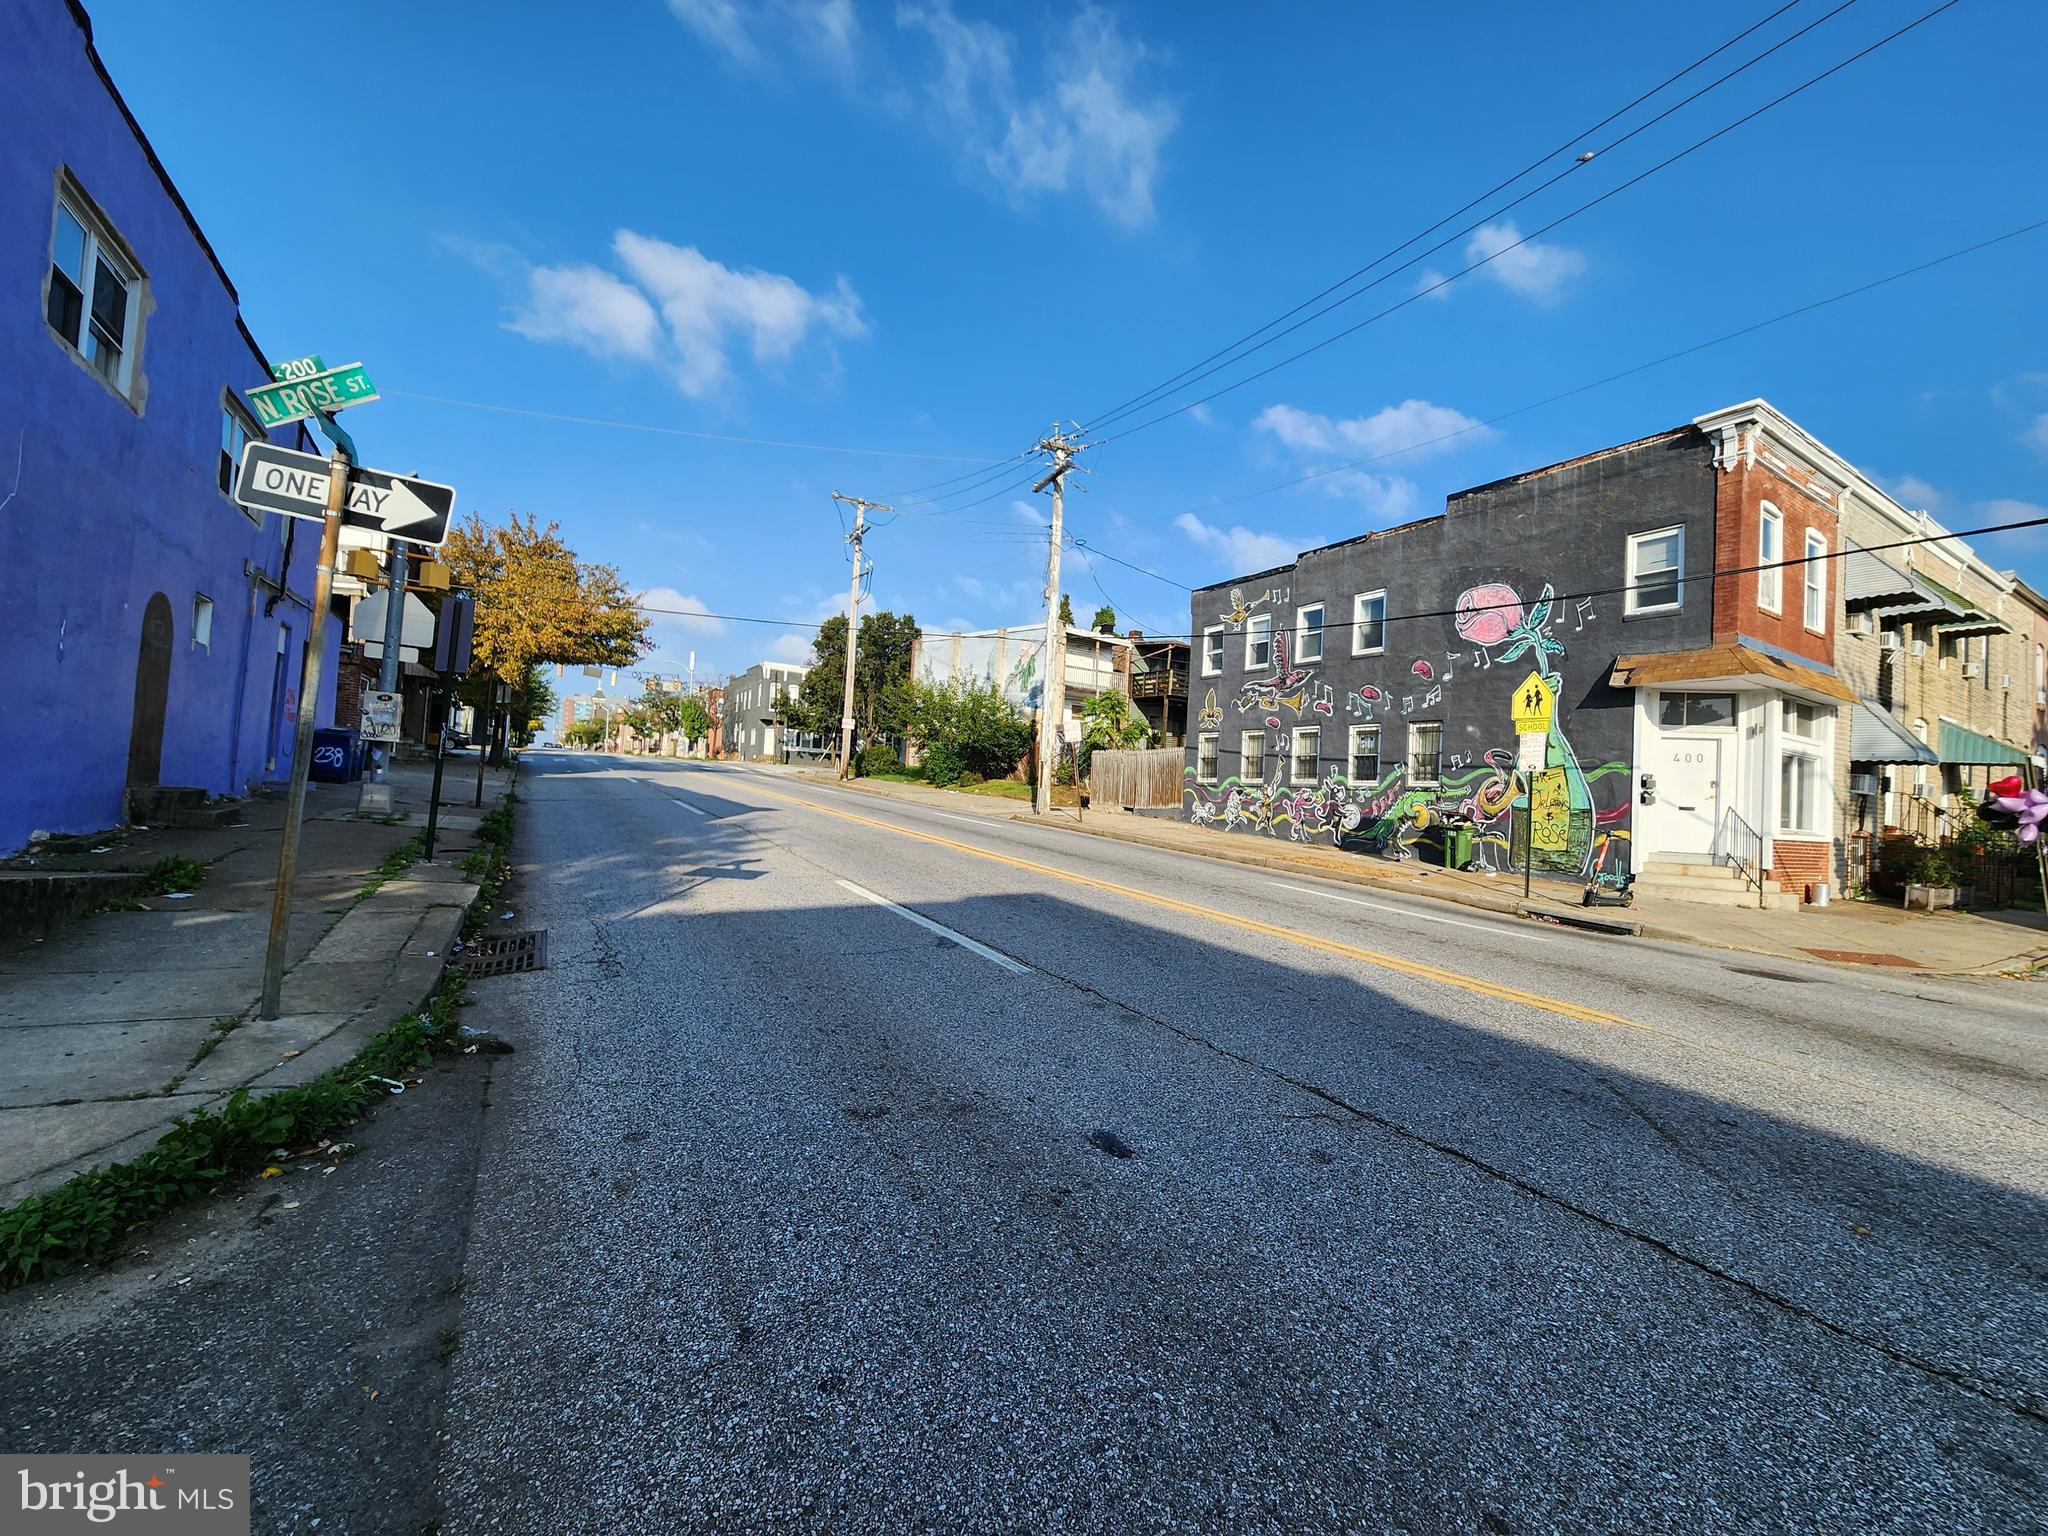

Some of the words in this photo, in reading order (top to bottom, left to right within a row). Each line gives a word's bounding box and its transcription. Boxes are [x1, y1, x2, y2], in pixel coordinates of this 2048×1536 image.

[281, 358, 317, 380] 200
[252, 395, 282, 422] N.
[279, 376, 345, 416] ROSE
[345, 375, 371, 393] ST.
[265, 468, 325, 501] ONE
[347, 484, 390, 513] AY
[1518, 723, 1547, 731] SCHOOL
[314, 746, 344, 768] 238
[1673, 753, 1704, 763] 400
